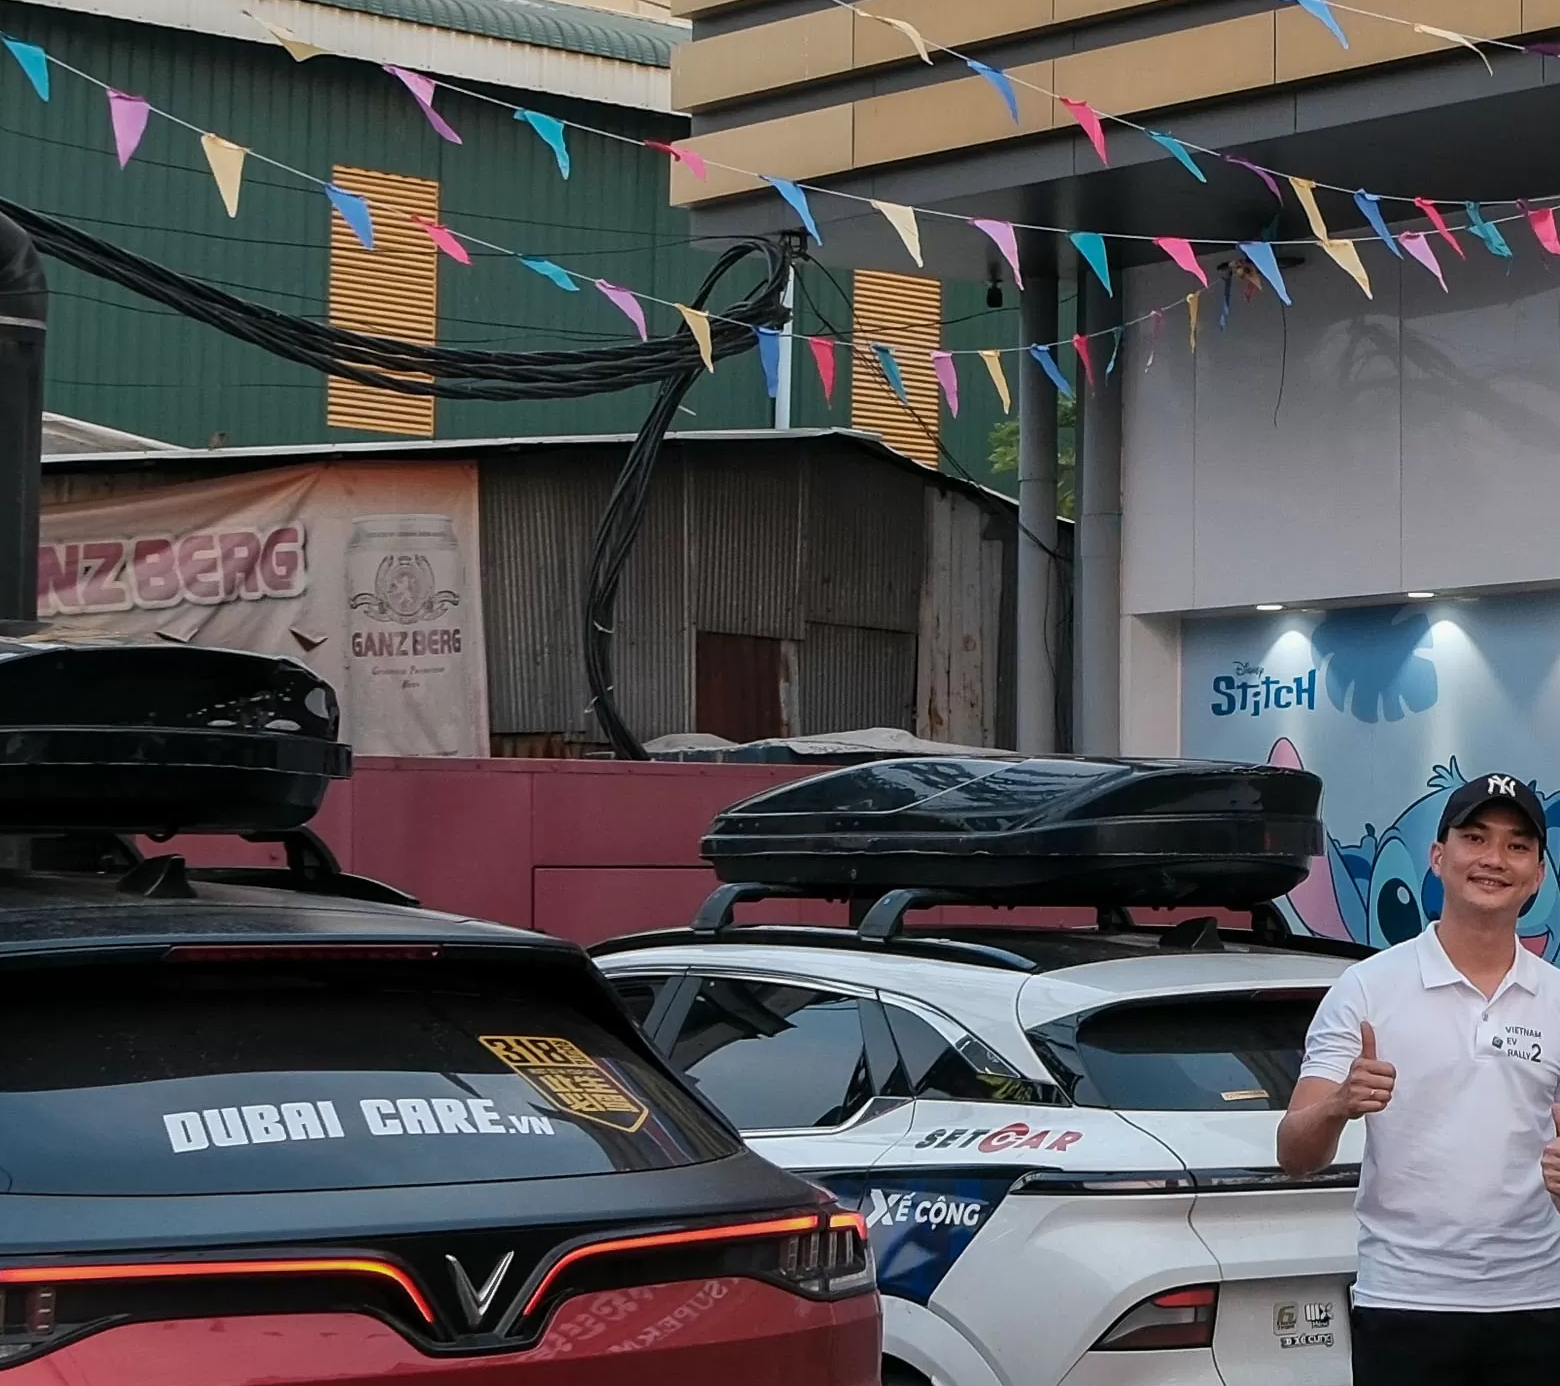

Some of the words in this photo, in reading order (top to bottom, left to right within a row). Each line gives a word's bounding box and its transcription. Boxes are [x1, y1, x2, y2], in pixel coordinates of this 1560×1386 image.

[1505, 1025, 1542, 1039] VIETNAM
[1506, 1037, 1517, 1046] EV
[484, 1038, 569, 1064] 318
[1507, 1048, 1531, 1062] RALLY
[1531, 1043, 1542, 1063] 2
[162, 1100, 345, 1154] DUBAI
[865, 1188, 917, 1229] XẾ
[914, 1195, 981, 1231] CỘNG
